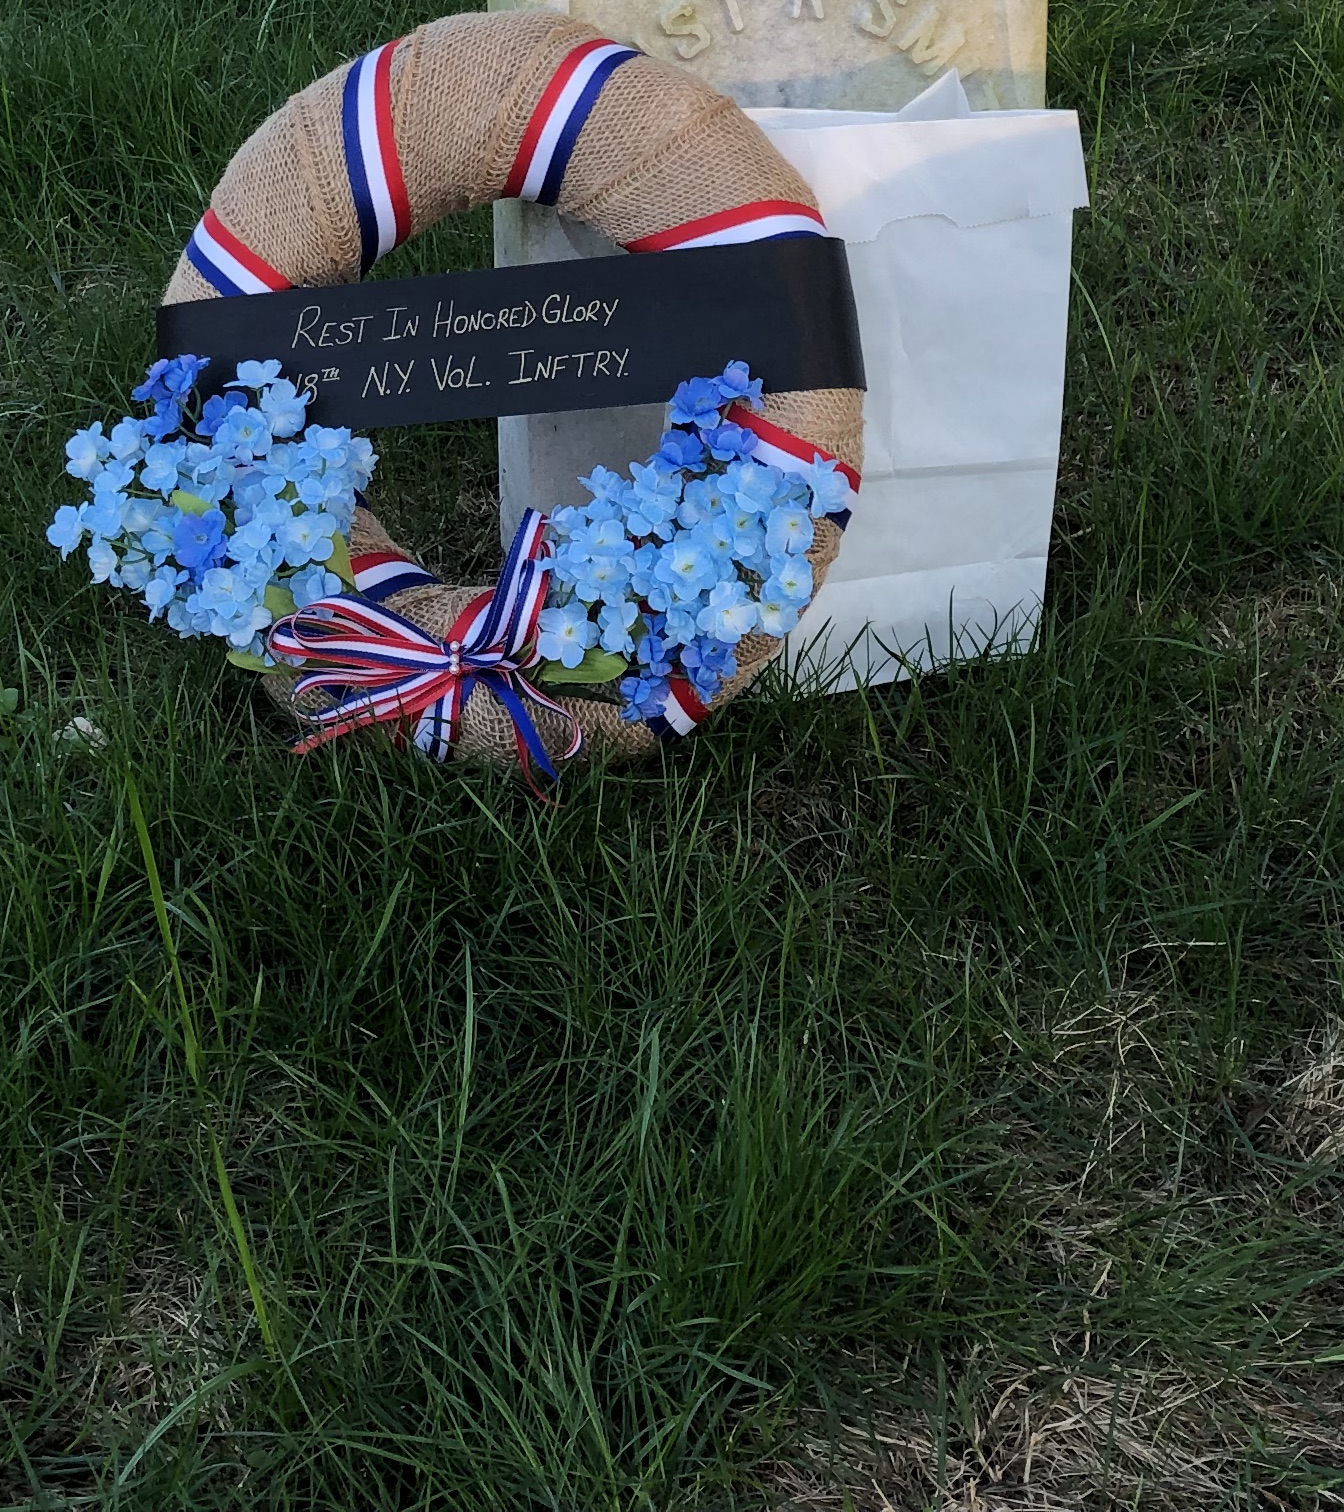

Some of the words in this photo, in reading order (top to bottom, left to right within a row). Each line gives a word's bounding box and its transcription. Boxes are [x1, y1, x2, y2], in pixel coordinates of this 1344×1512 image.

[291, 304, 375, 349] REST
[382, 306, 420, 341] IN
[432, 299, 536, 338] HONORED
[541, 294, 620, 328] GLORY
